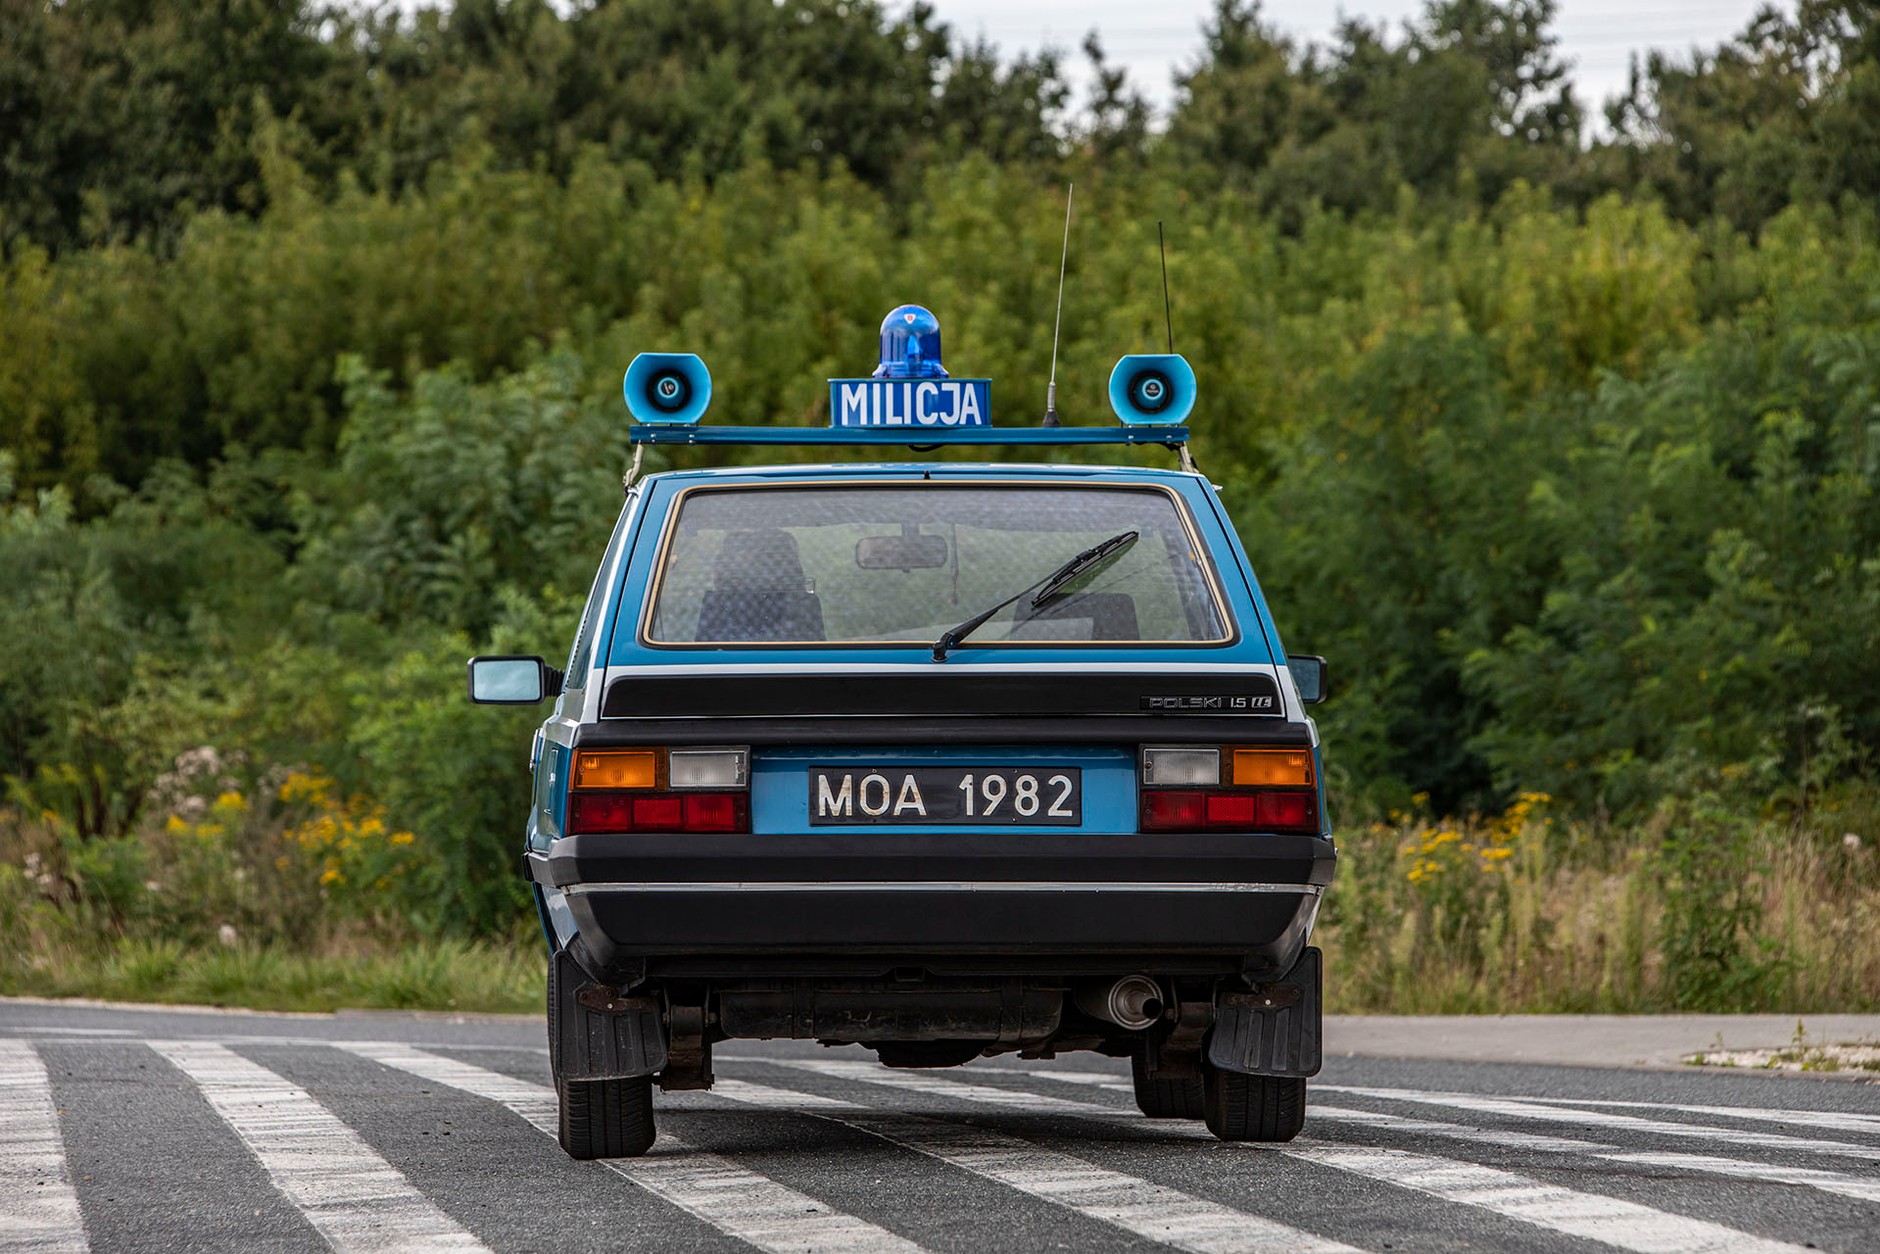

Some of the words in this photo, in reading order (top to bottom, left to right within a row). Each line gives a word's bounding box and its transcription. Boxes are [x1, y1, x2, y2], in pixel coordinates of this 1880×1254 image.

[841, 382, 982, 425] MILICJA
[1150, 697, 1222, 708] POLSKI
[818, 774, 928, 817] MOA
[958, 774, 1073, 817] 1982
